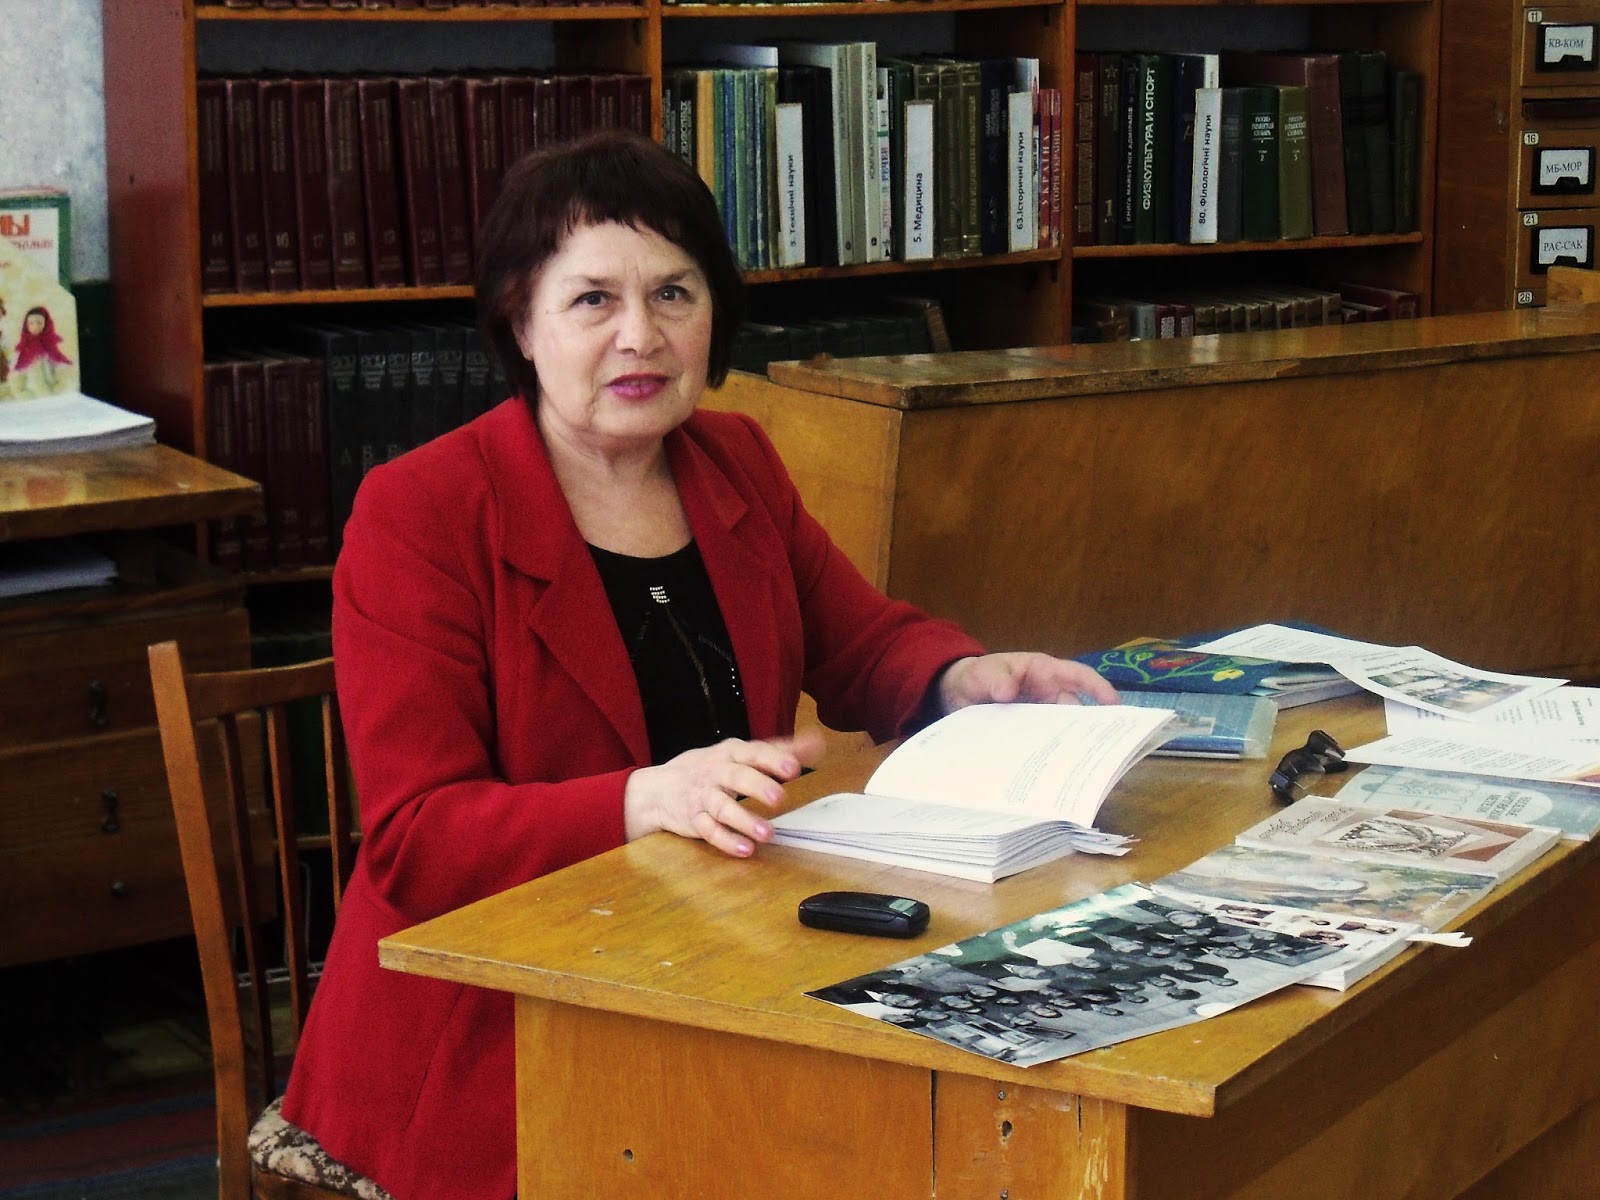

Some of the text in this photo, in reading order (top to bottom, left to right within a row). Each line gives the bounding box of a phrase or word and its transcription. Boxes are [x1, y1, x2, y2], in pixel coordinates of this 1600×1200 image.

[1531, 12, 1538, 21] 11
[1548, 38, 1584, 48] КВ-КОМ
[1017, 131, 1026, 163] науки
[1142, 67, 1156, 210] ФИЗКУЛЬТУРА И СПОРТ
[1526, 134, 1536, 144] 16
[787, 154, 797, 187] науки
[1041, 135, 1050, 206] УКРАЇНА
[1198, 114, 1212, 224] 80. Філологічні науки
[1545, 161, 1582, 173] МБ-МОР
[787, 190, 797, 235] Технічні
[913, 173, 923, 243] 5. Медицина
[1526, 214, 1536, 224] 21
